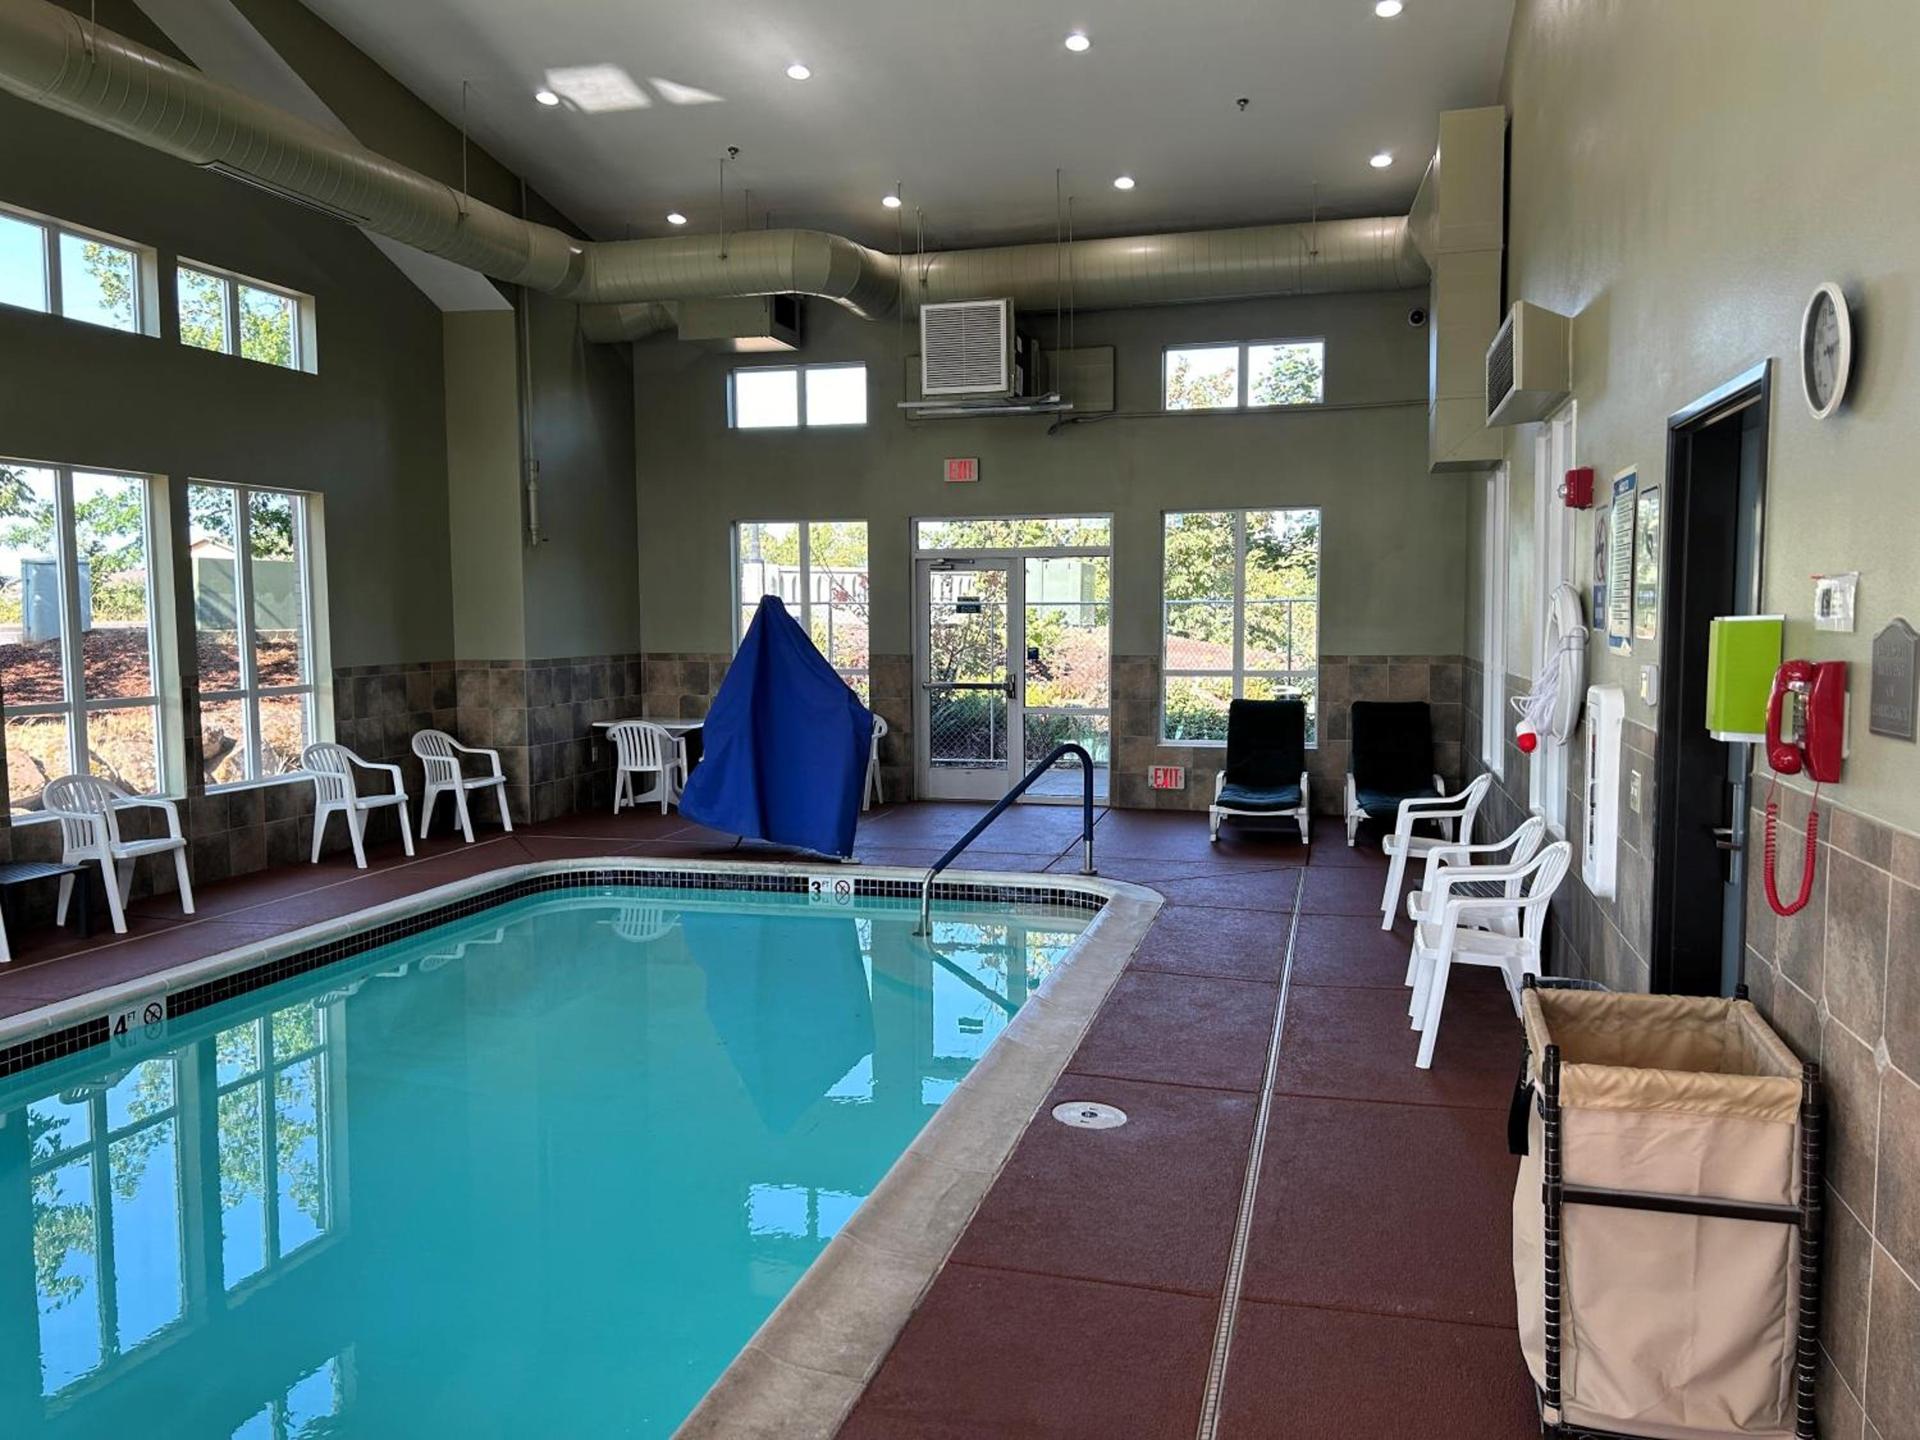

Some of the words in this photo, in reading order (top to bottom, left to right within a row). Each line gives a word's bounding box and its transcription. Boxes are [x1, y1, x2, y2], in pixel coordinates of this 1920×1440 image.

[949, 461, 975, 479] EXIT
[1154, 767, 1179, 787] EXIT
[811, 880, 821, 894] 3
[114, 1014, 128, 1036] 4
[127, 1010, 136, 1021] FT
